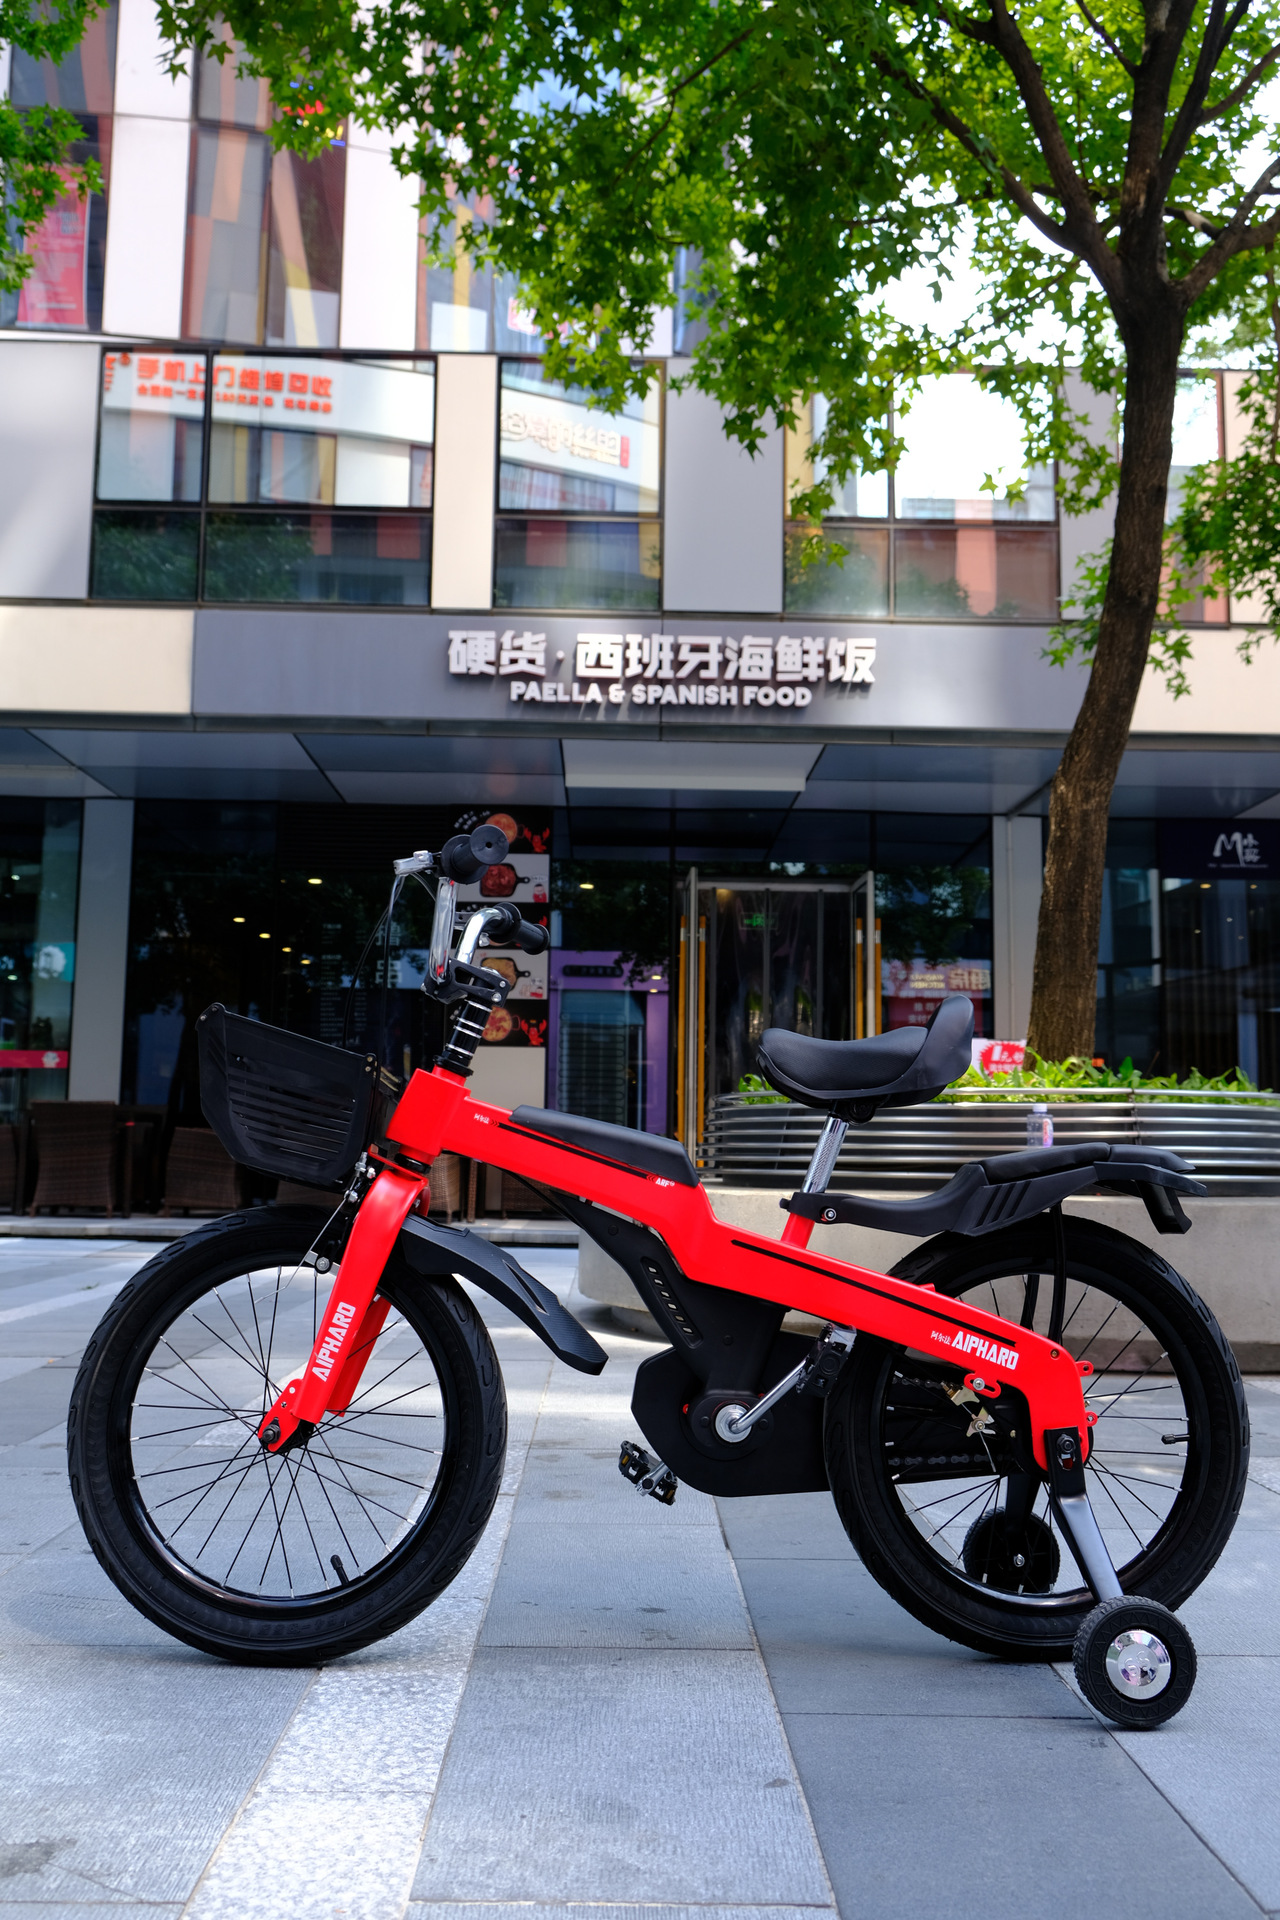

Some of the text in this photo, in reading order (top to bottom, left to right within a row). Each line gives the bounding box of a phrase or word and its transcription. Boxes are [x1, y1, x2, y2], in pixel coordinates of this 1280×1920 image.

[449, 631, 877, 683] 硬货·西班牙海鲜饭
[510, 681, 812, 707] PAELLA & SPANISH FOOD
